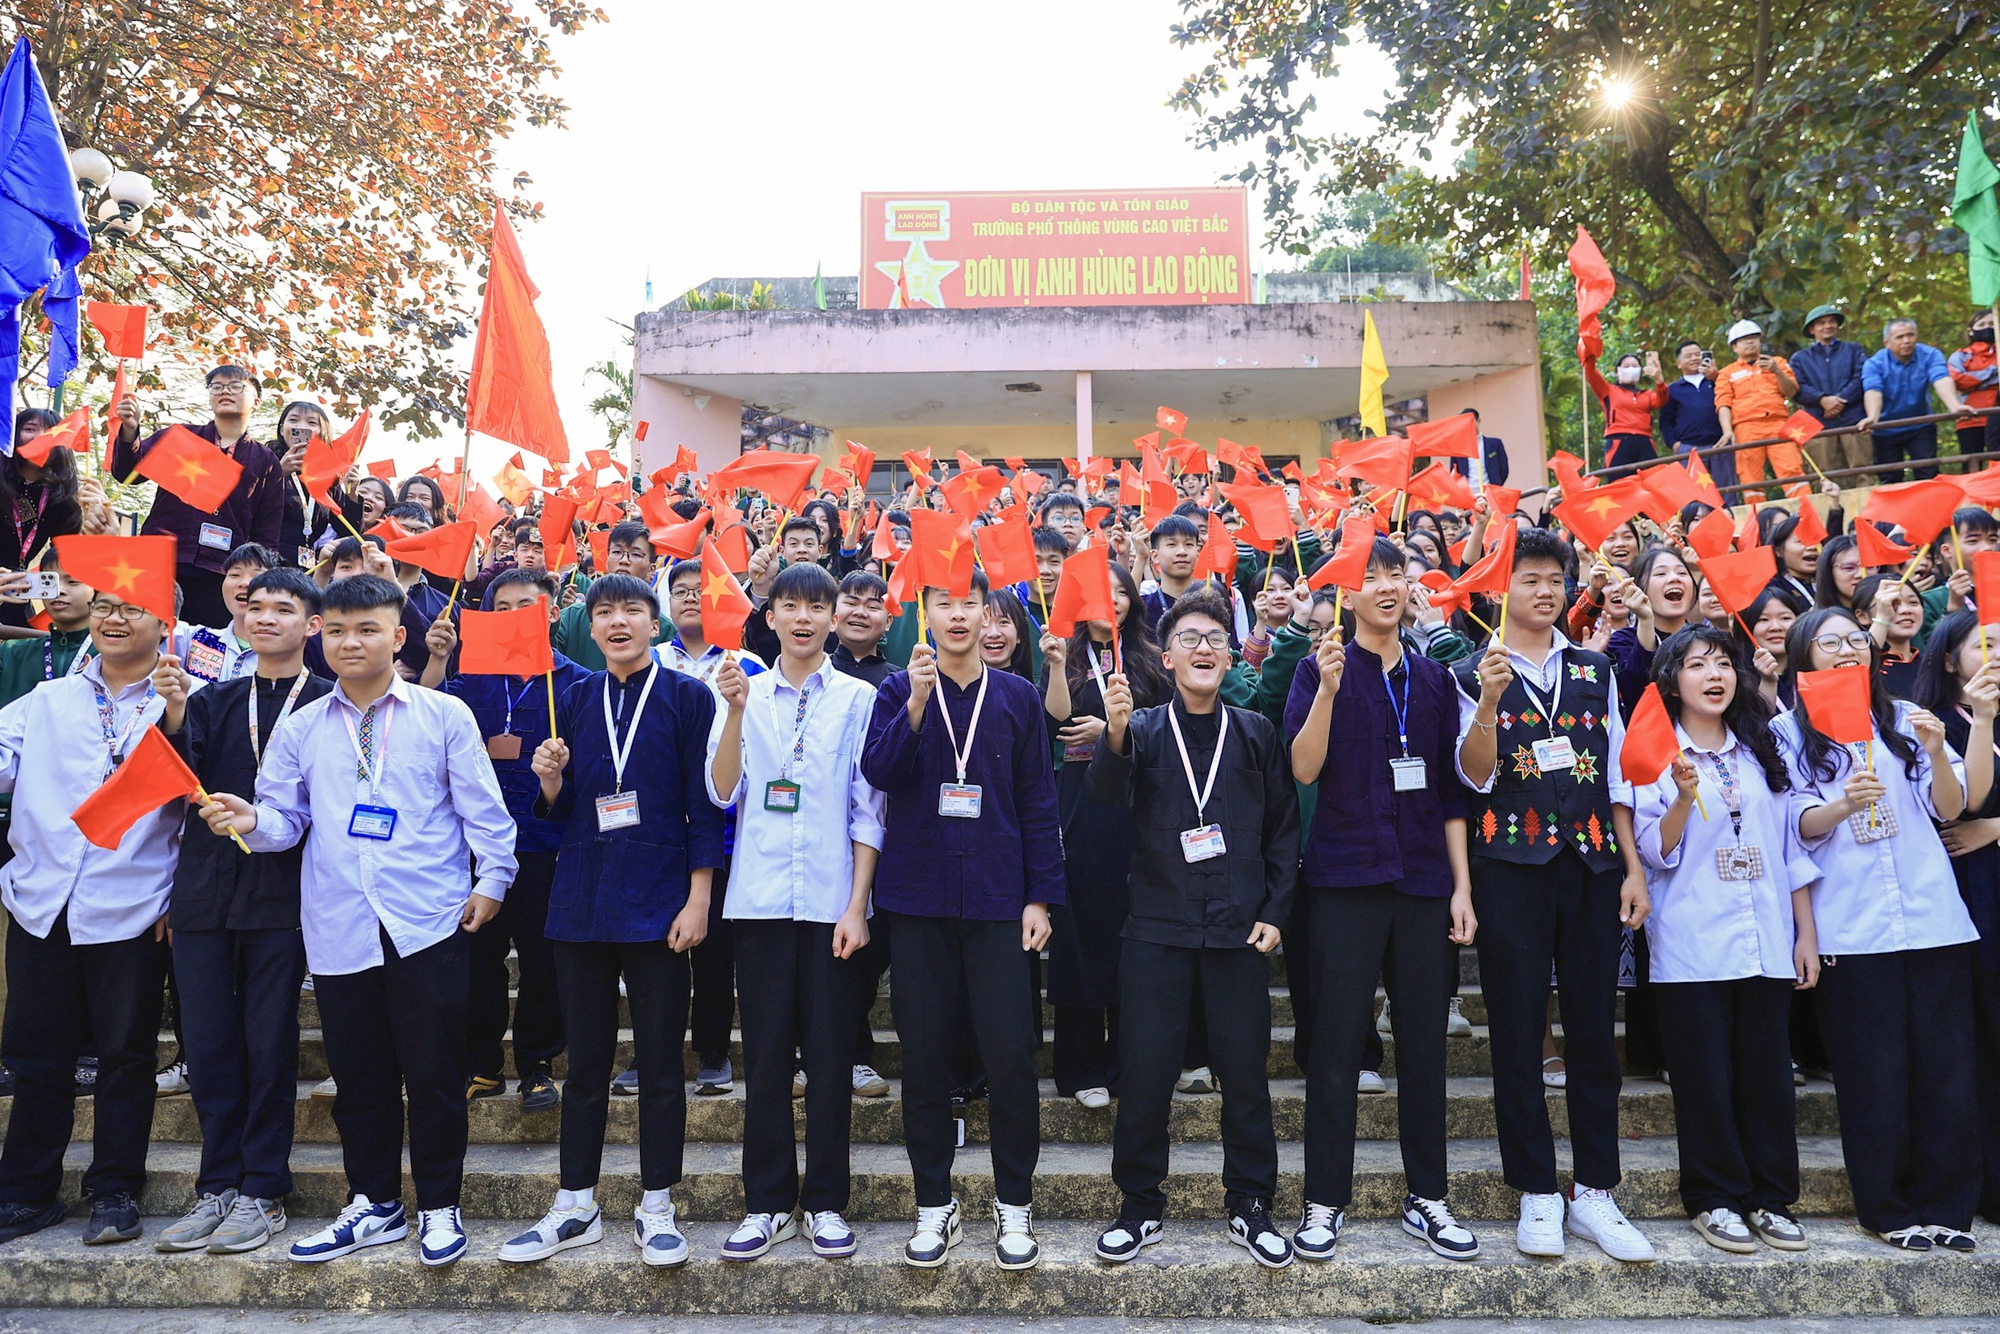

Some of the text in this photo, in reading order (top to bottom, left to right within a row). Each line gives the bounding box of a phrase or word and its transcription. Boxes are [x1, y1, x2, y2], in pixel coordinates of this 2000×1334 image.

[897, 211, 938, 220] ANH HÙNG
[1011, 197, 1189, 216] BỘ DÂN TỘC VÀ TÔN GIÁO
[897, 221, 914, 229] LAO
[972, 212, 1229, 237] TRƯỜNG PHỔ THÔNG VÙNG CAO VIỆT BẮC
[964, 246, 1239, 306] ĐƠN VỊ ANH HÙNG LAO ĐỘNG
